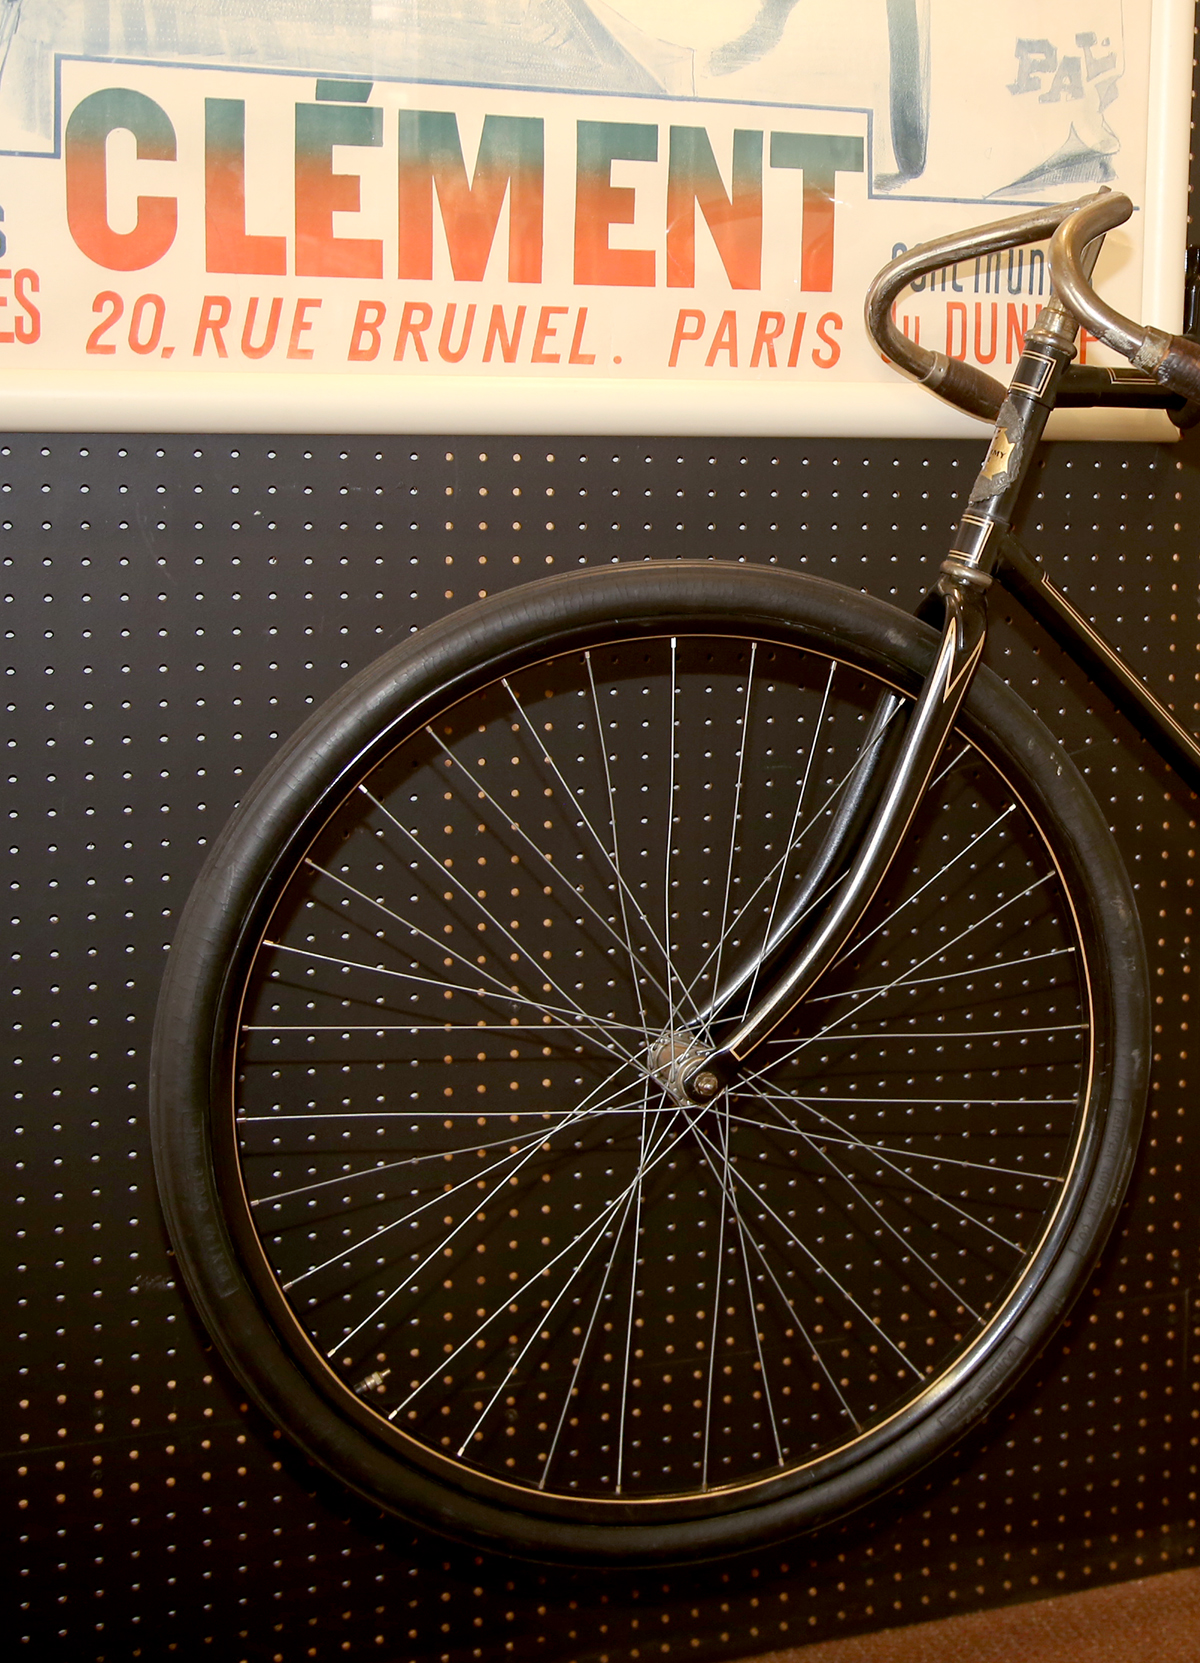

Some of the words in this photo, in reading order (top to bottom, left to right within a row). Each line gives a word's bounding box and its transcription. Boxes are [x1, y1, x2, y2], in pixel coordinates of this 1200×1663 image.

[64, 78, 865, 293] CLÉMENT
[84, 290, 176, 360] 20,
[192, 295, 323, 362] RUE
[667, 308, 844, 369] PARIS
[946, 301, 1100, 365] DUNP
